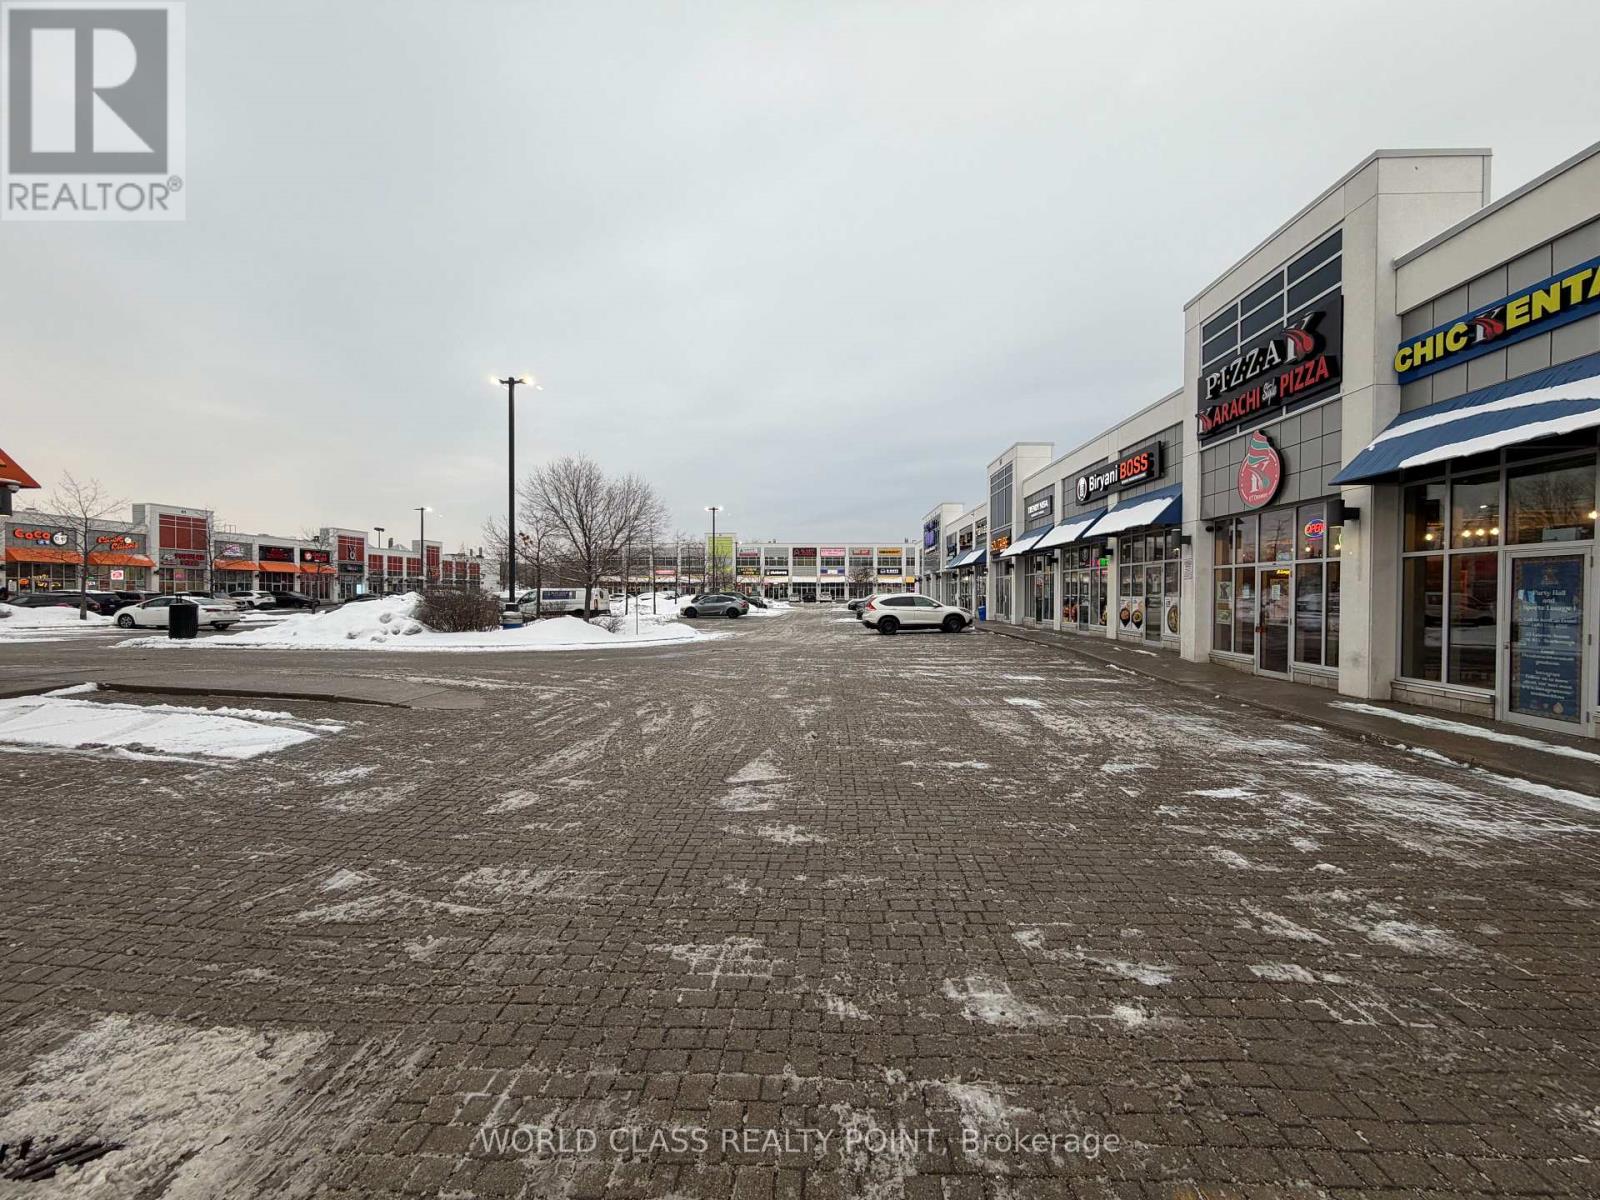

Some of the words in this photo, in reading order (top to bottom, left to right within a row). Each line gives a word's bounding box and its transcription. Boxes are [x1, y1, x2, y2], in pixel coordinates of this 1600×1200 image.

[1280, 355, 1329, 398] PIZZA
[1088, 465, 1118, 492] Biryani
[1120, 452, 1149, 480] BOSS
